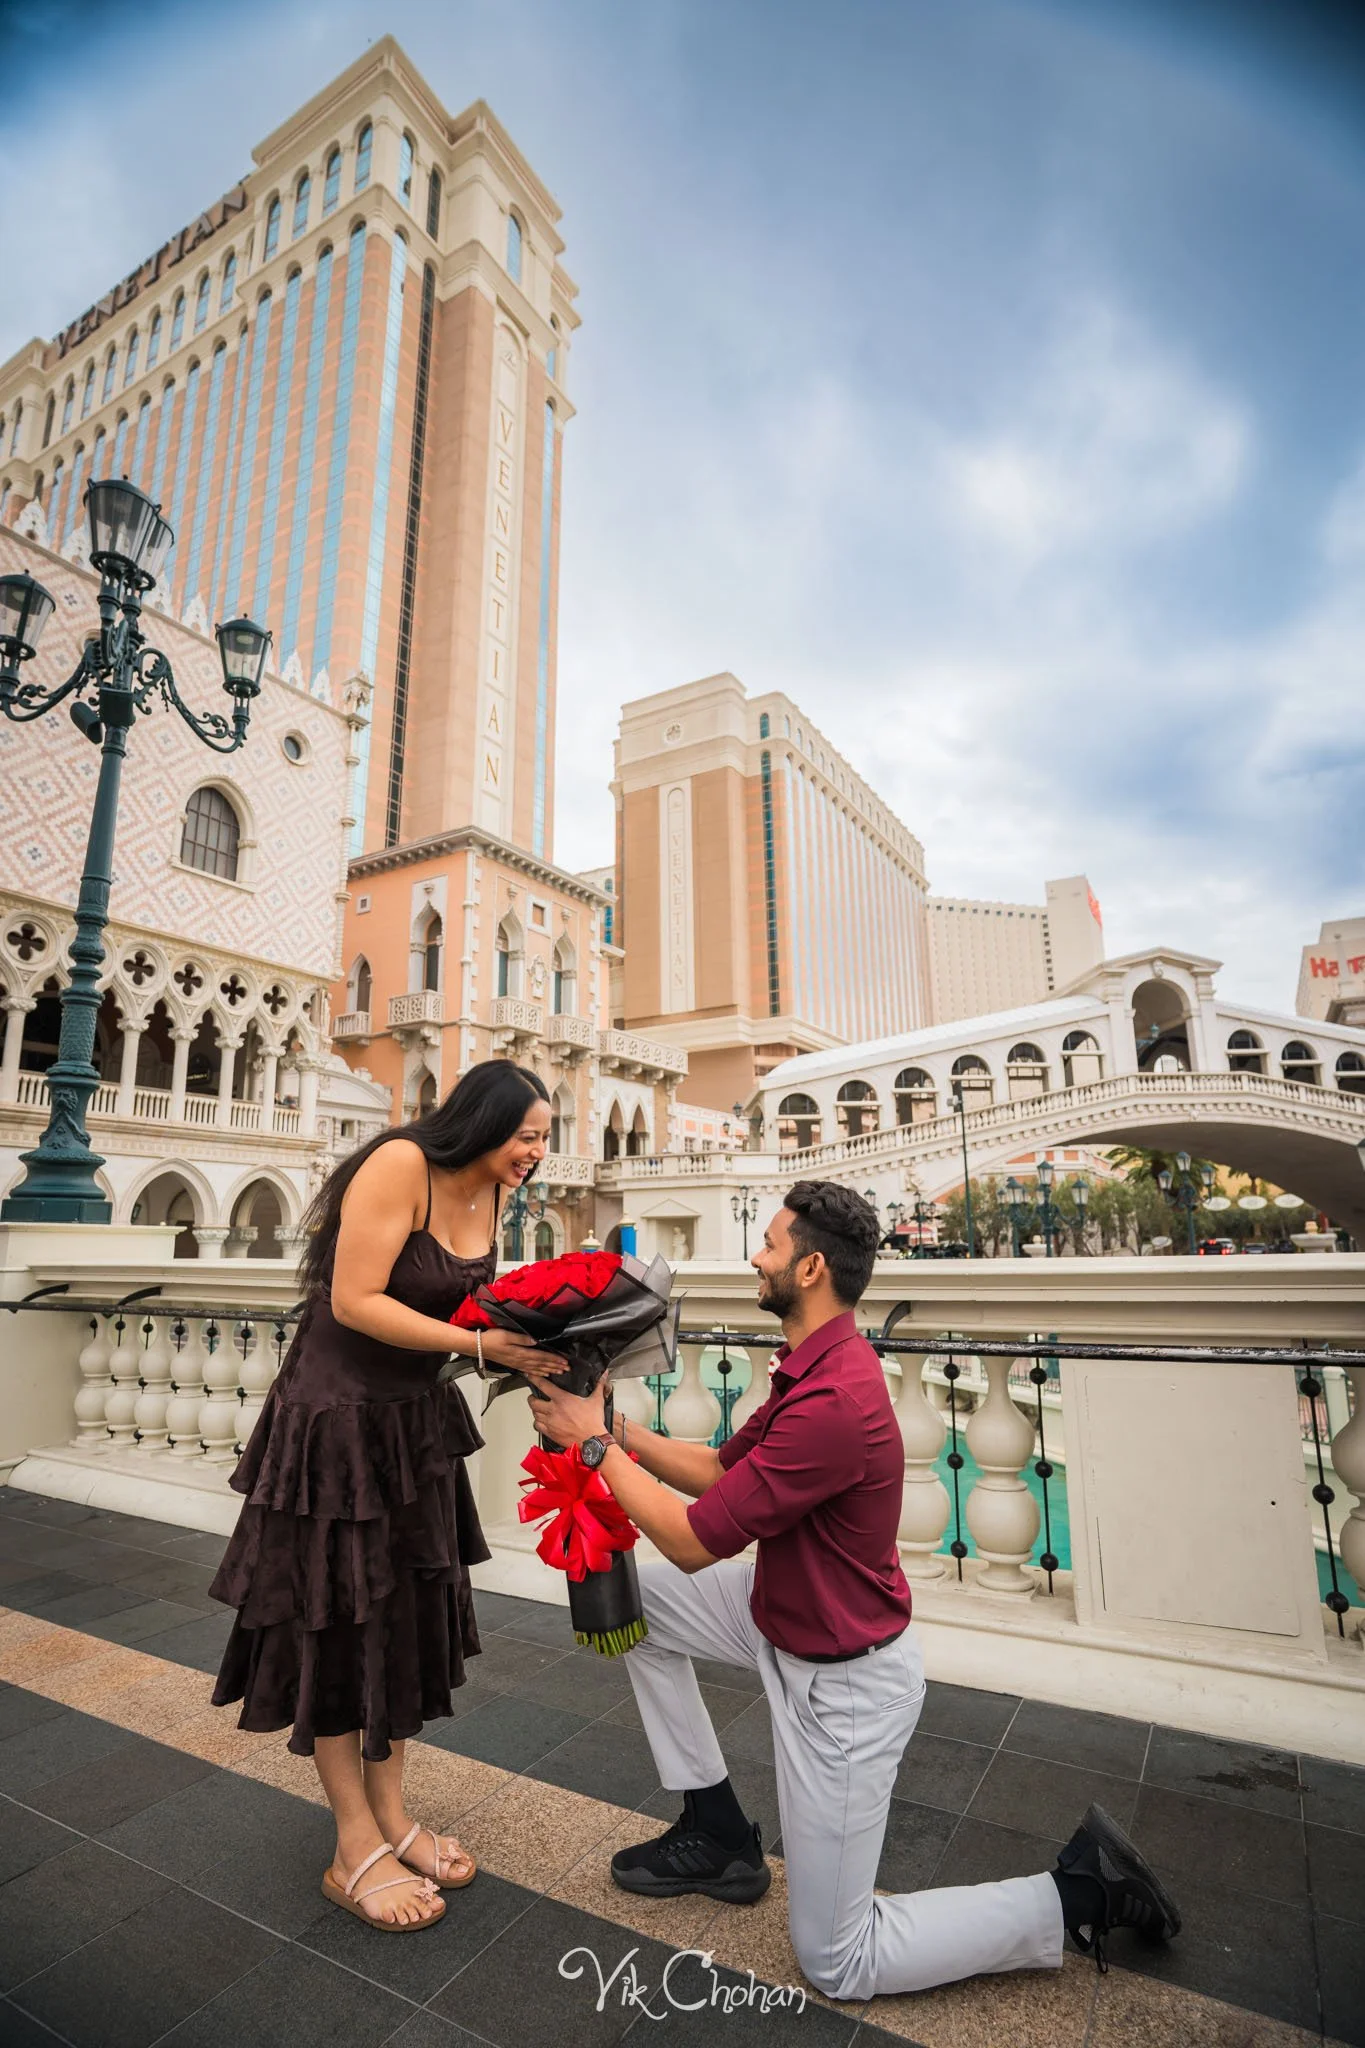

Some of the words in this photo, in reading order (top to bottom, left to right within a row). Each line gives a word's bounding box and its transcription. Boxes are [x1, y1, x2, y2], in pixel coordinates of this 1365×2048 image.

[52, 174, 250, 360] VENETIAN
[484, 411, 514, 786] VENETIAN
[672, 834, 683, 988] VENETIAN
